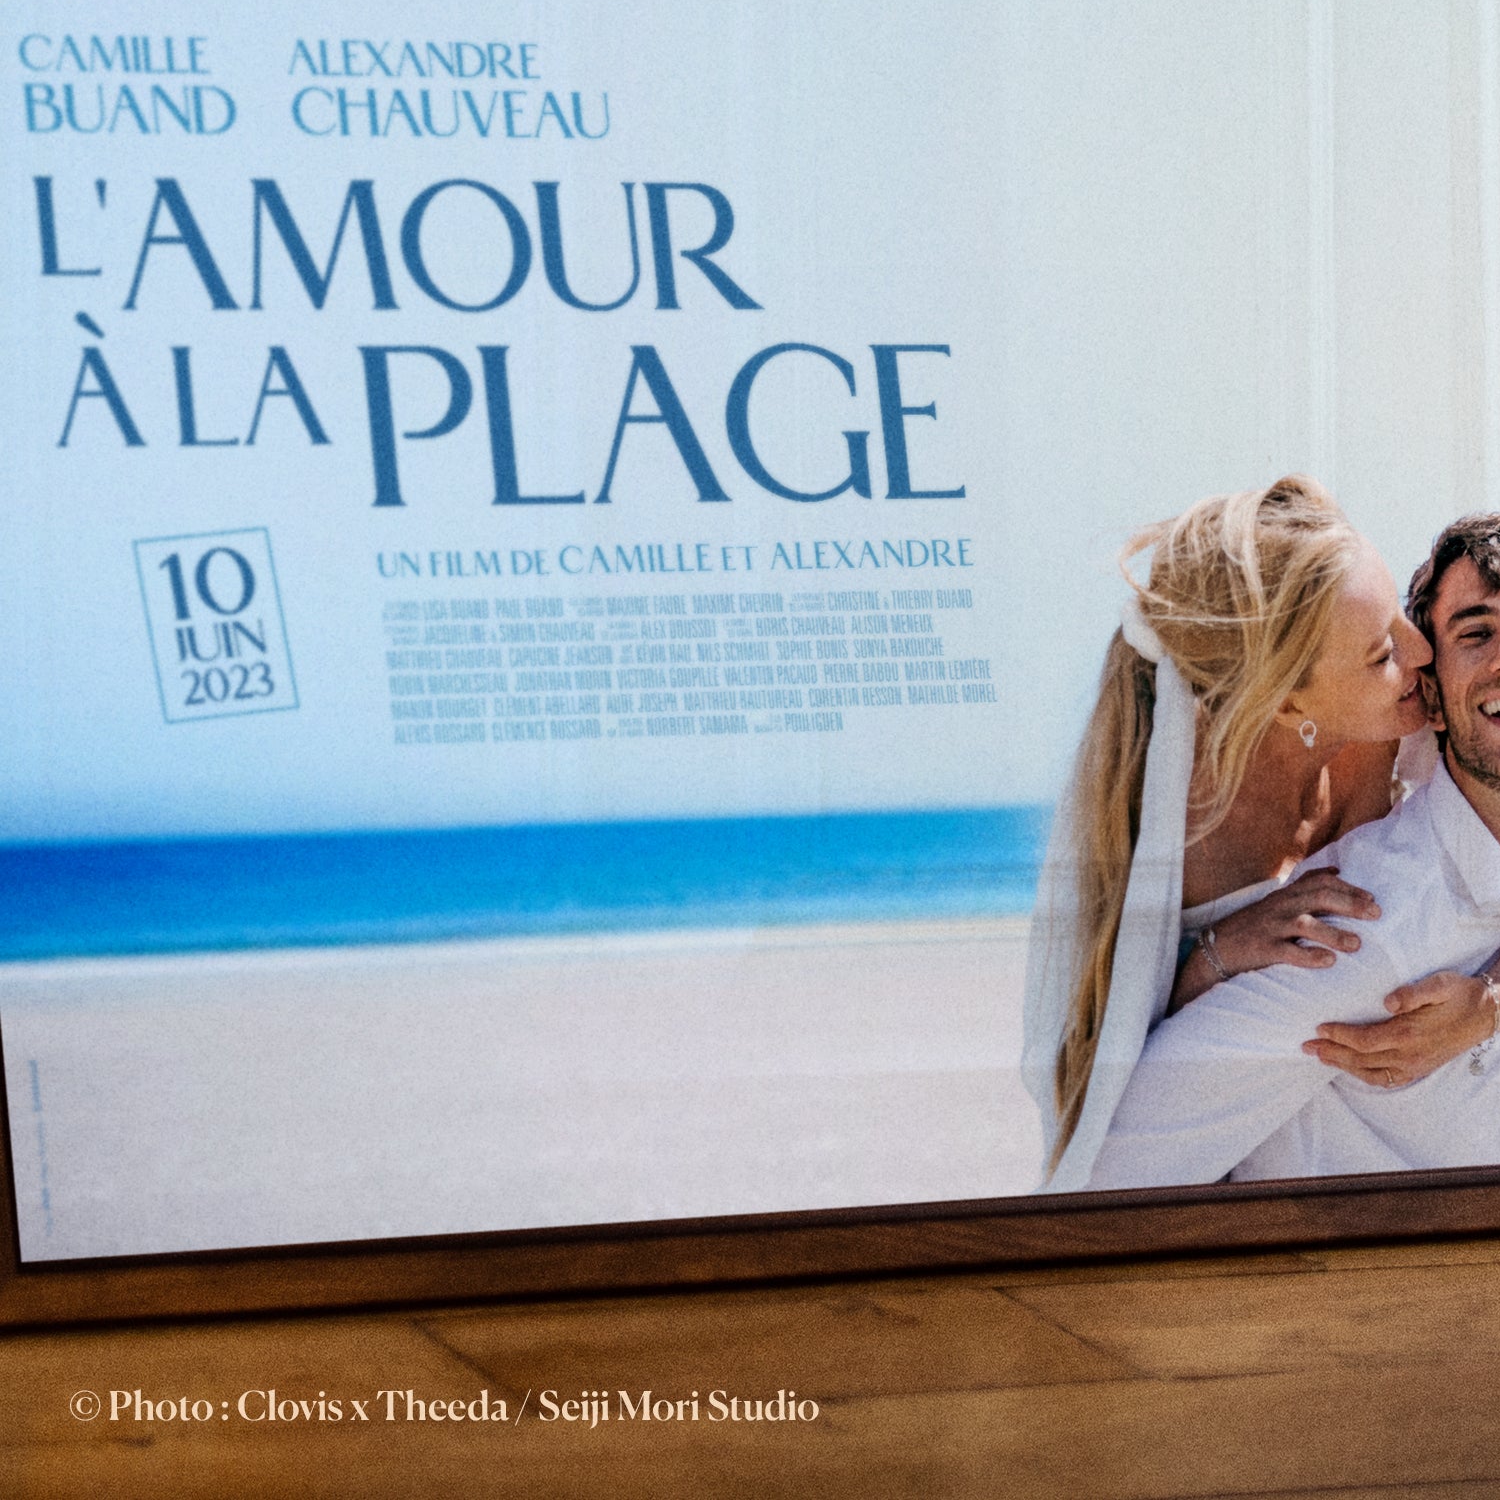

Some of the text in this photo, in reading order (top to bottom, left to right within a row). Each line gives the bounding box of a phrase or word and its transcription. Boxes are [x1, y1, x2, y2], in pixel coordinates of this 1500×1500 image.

[18, 32, 542, 79] CAMILLE ALEXANDRE
[22, 82, 611, 139] BUAND CHAUVEAU
[32, 176, 765, 311] L'AMOUR
[57, 311, 967, 506] À LA PLAGE
[377, 538, 975, 578] UN FILM DE CAMILLE ET ALEXANDRE
[159, 546, 256, 621] 10
[828, 591, 880, 611] CHRISTINE
[891, 590, 933, 610] THIERRY
[937, 589, 973, 609] BUAND
[176, 618, 267, 663] JUIN
[791, 616, 845, 635] CHAUVEAU
[851, 615, 888, 634] ALISON
[776, 640, 812, 660] SOPHIE
[853, 638, 888, 658] SONYA
[823, 663, 859, 683] PIERRE
[904, 660, 946, 681] MARTIN
[181, 661, 275, 706] 2023
[907, 684, 959, 704] MATHILDE
